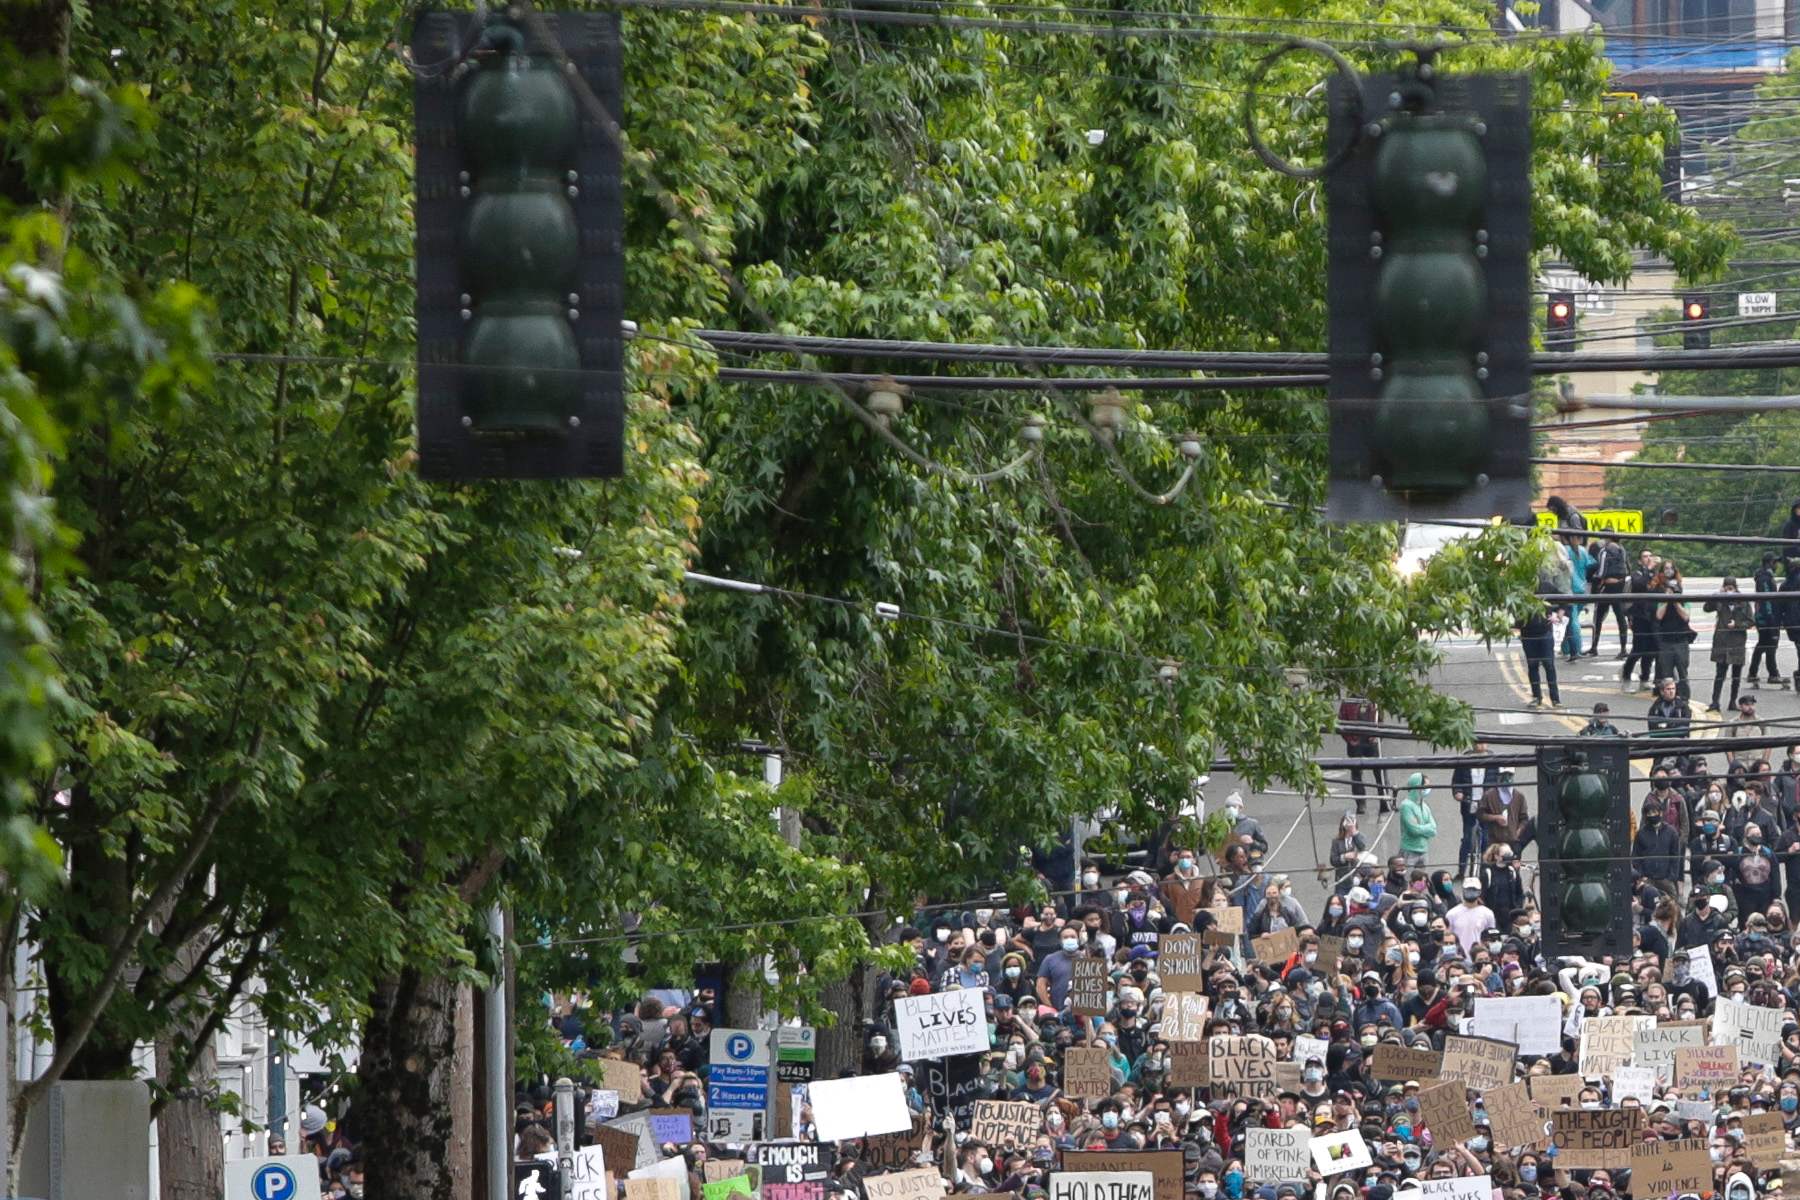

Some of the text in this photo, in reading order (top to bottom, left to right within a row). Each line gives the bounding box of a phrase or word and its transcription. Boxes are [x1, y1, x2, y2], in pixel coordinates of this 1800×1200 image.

[1745, 295, 1770, 304] SLOW
[1074, 959, 1103, 973] BLACK
[1074, 976, 1104, 992] LIVES
[904, 993, 968, 1018] BLACK
[1073, 993, 1104, 1010] MATTER
[919, 1006, 977, 1030] LIVES
[911, 1026, 979, 1049] MATTER
[1640, 1029, 1691, 1044] BLACK
[1211, 1038, 1275, 1058] BLACK
[1067, 1050, 1107, 1066] BLACK
[1211, 1058, 1273, 1079] LIVES
[928, 1067, 984, 1097] BLACK
[1066, 1079, 1110, 1098] MATTER
[1210, 1080, 1276, 1100] MATTER
[711, 1087, 720, 1099] 2
[1555, 1111, 1641, 1129] THE RIGHT
[1248, 1132, 1295, 1147] SCARED
[1553, 1130, 1643, 1149] OF PEOPLE
[757, 1146, 819, 1167] ENOUGH
[1257, 1147, 1307, 1164] OF PINK
[786, 1165, 804, 1184] IS
[868, 1179, 894, 1197] NO
[1422, 1180, 1456, 1196] BLACK
[1648, 1176, 1701, 1194] VIOLENCE
